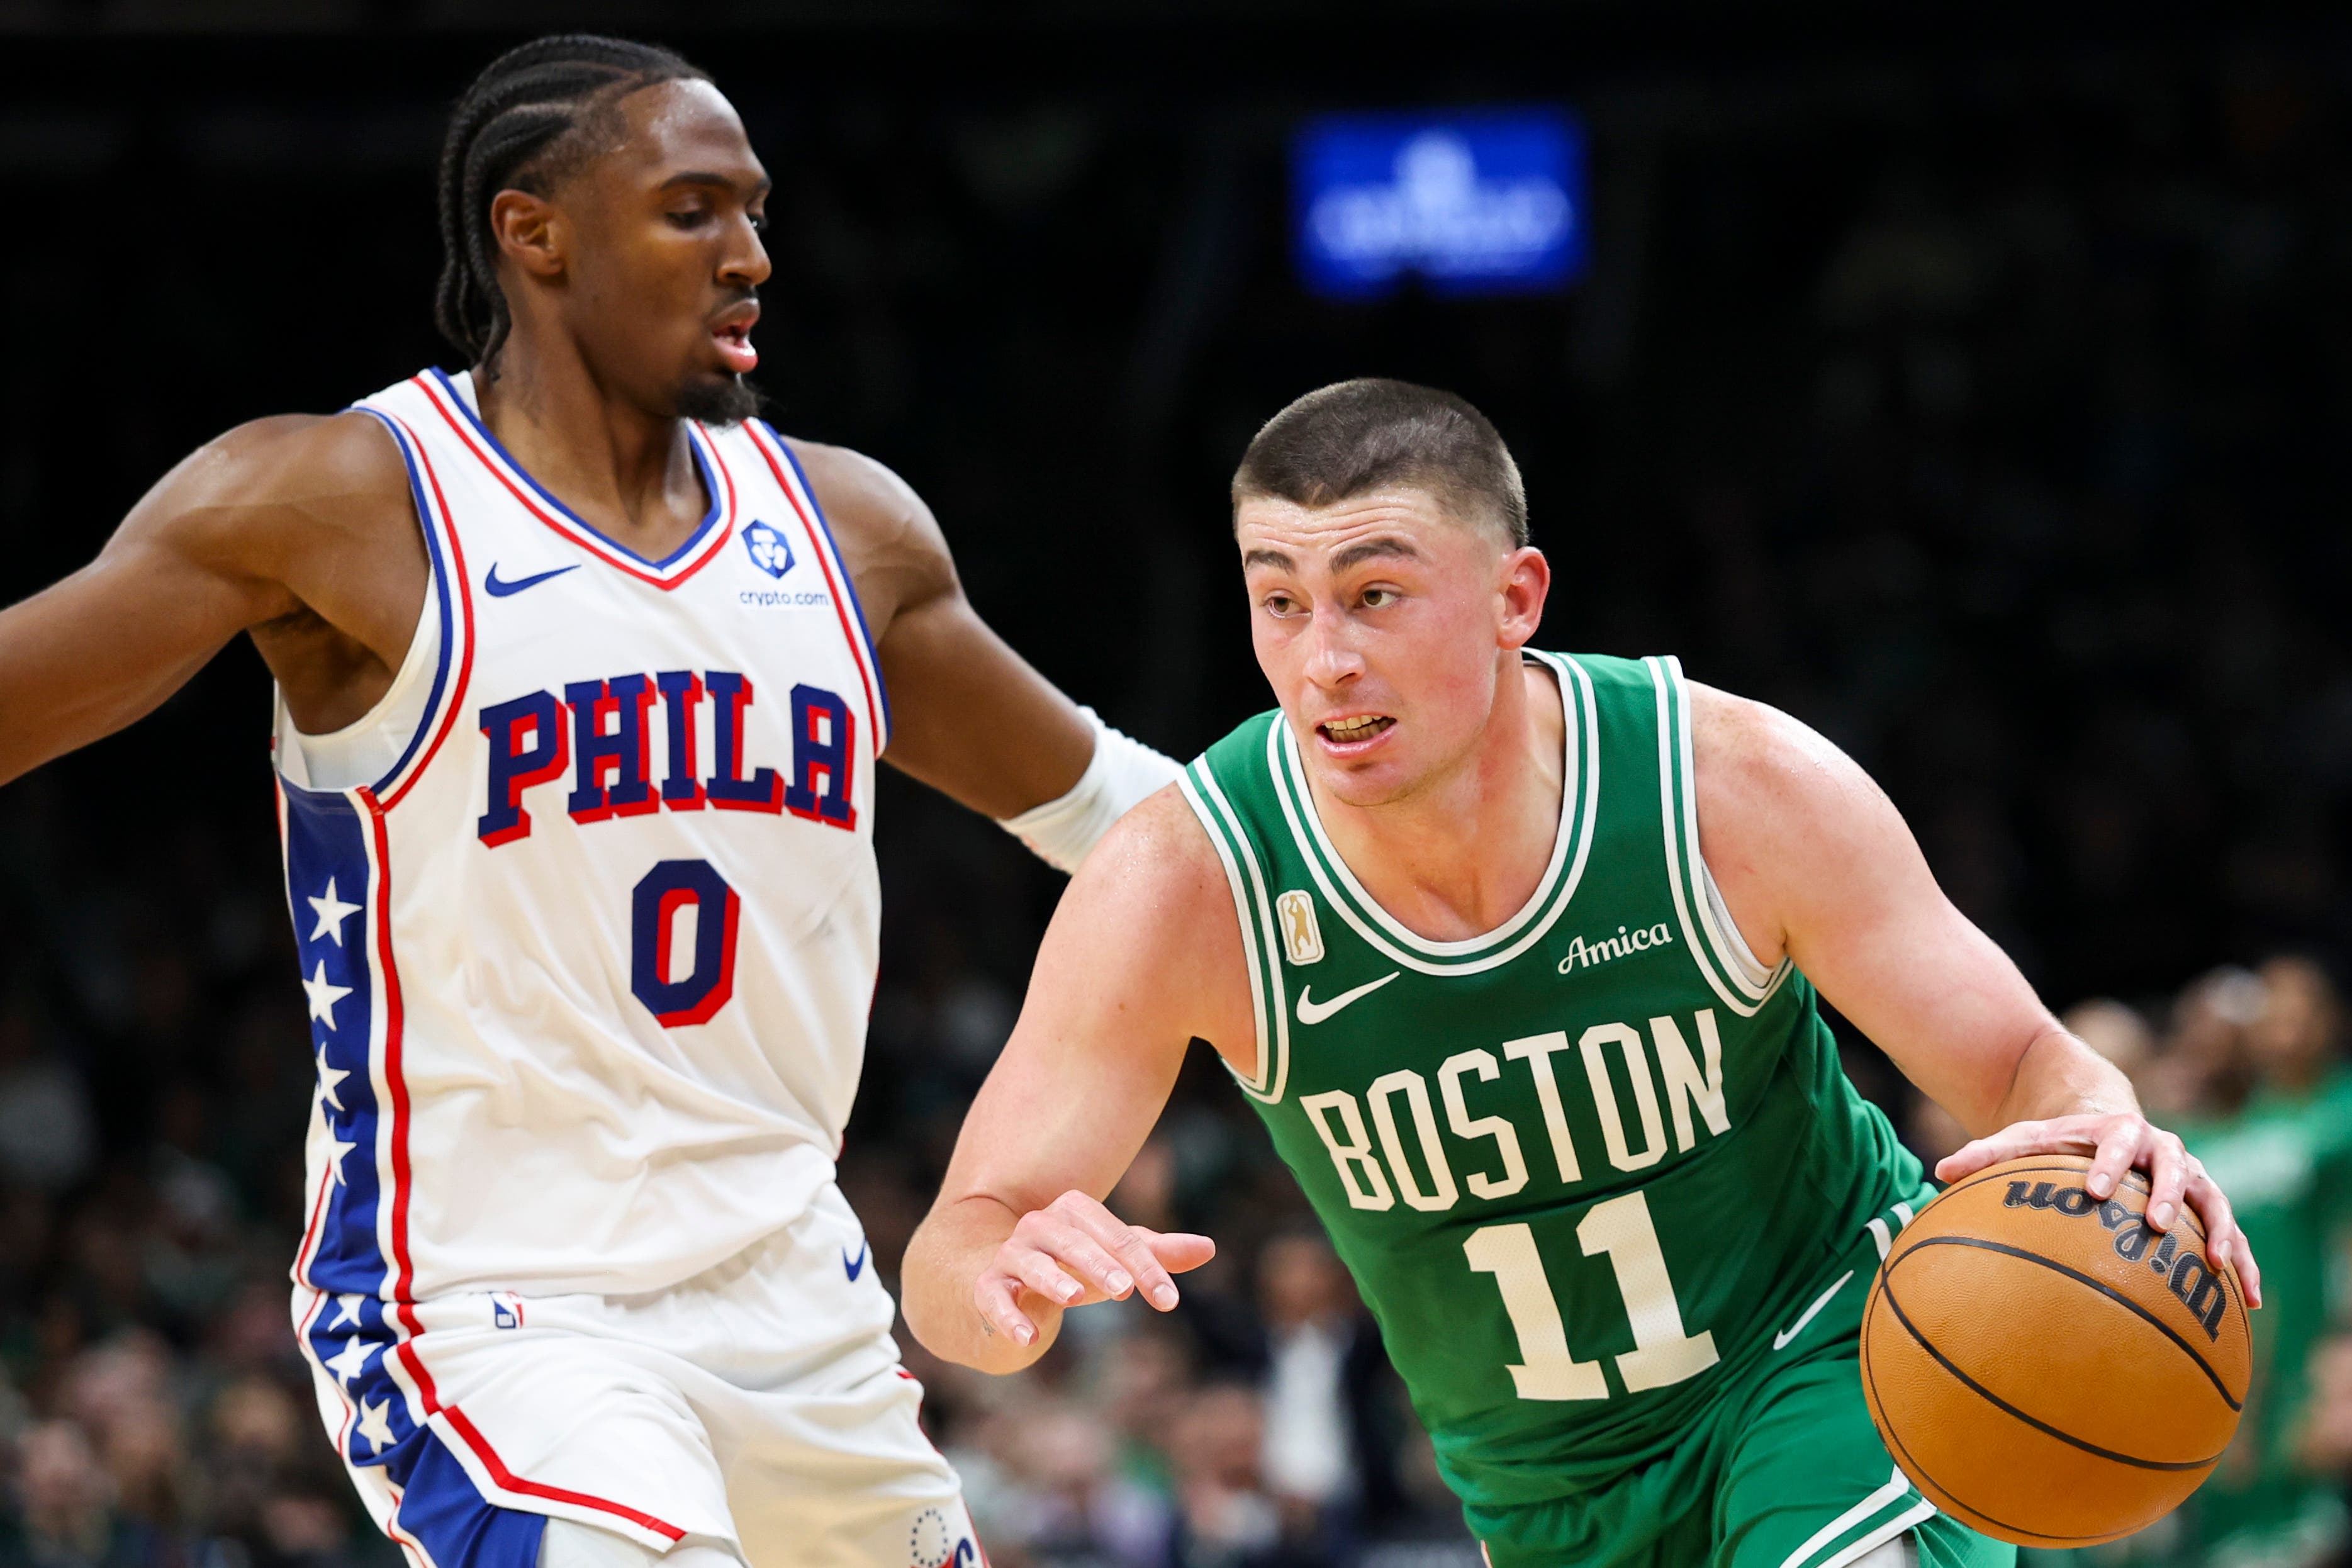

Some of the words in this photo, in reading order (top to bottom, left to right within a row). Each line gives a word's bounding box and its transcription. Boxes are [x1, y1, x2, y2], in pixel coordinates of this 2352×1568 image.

[739, 590, 829, 607] crypto.com
[478, 670, 856, 849] PHILA
[631, 859, 740, 1029] 0
[1557, 922, 1673, 975] Amica
[1299, 1008, 1732, 1212] BOSTON
[1462, 1190, 1721, 1401] 11
[2003, 1180, 2227, 1343] Wilson
